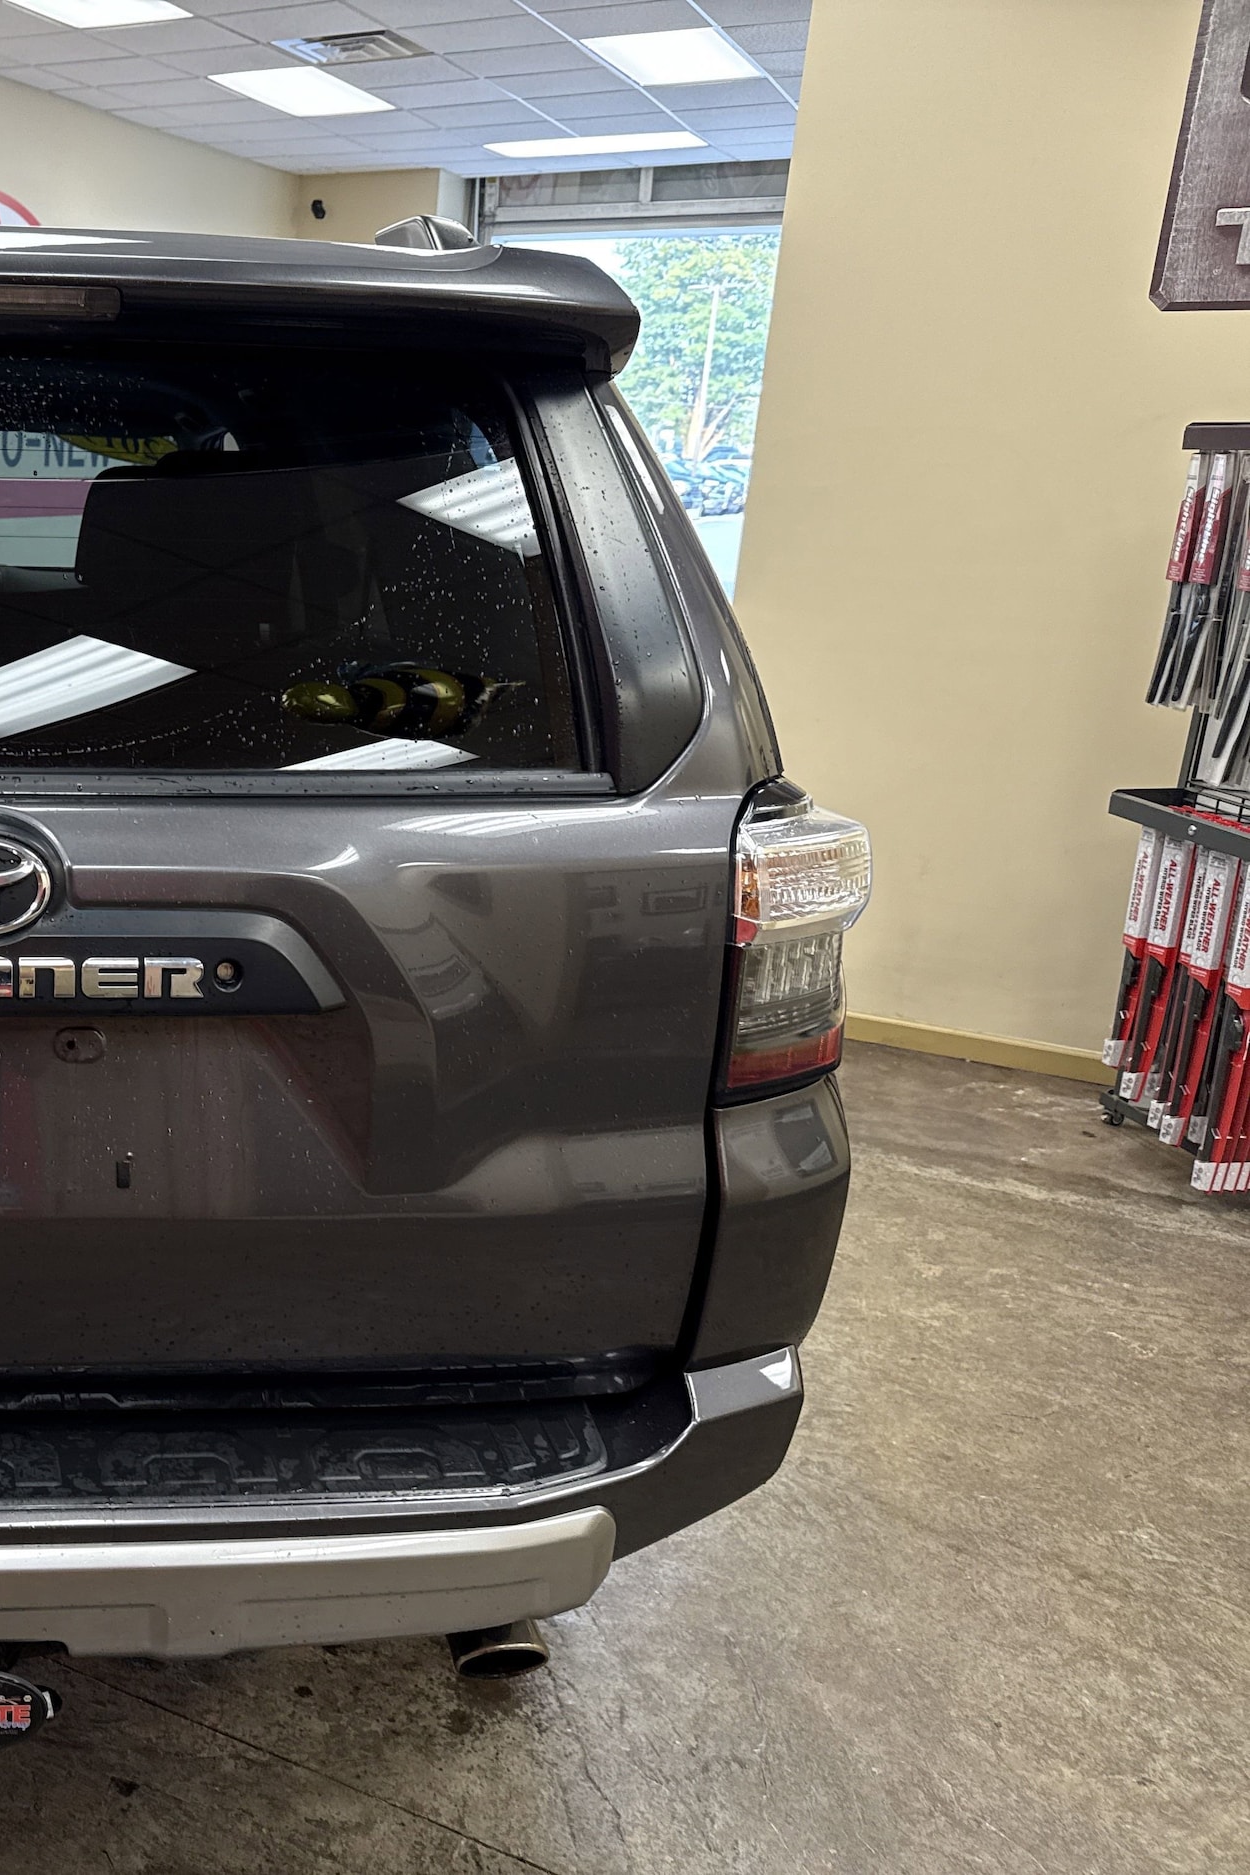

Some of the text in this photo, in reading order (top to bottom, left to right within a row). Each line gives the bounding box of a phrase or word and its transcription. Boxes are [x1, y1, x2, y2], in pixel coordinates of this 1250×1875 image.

[1133, 851, 1149, 922] ALL-WEATHER
[1160, 867, 1168, 890] HYBRID
[1194, 875, 1202, 899] HYBRID
[1159, 859, 1177, 932] ALL-WEATHER
[1203, 886, 1211, 911] HYBRID
[1153, 910, 1161, 930] BLADE
[1199, 911, 1207, 931] WIPER
[1201, 878, 1221, 953] ALL-WEATHER
[1242, 901, 1250, 926] HYBRID
[1196, 931, 1204, 951] BLADE
[1233, 947, 1241, 968] BLADE
